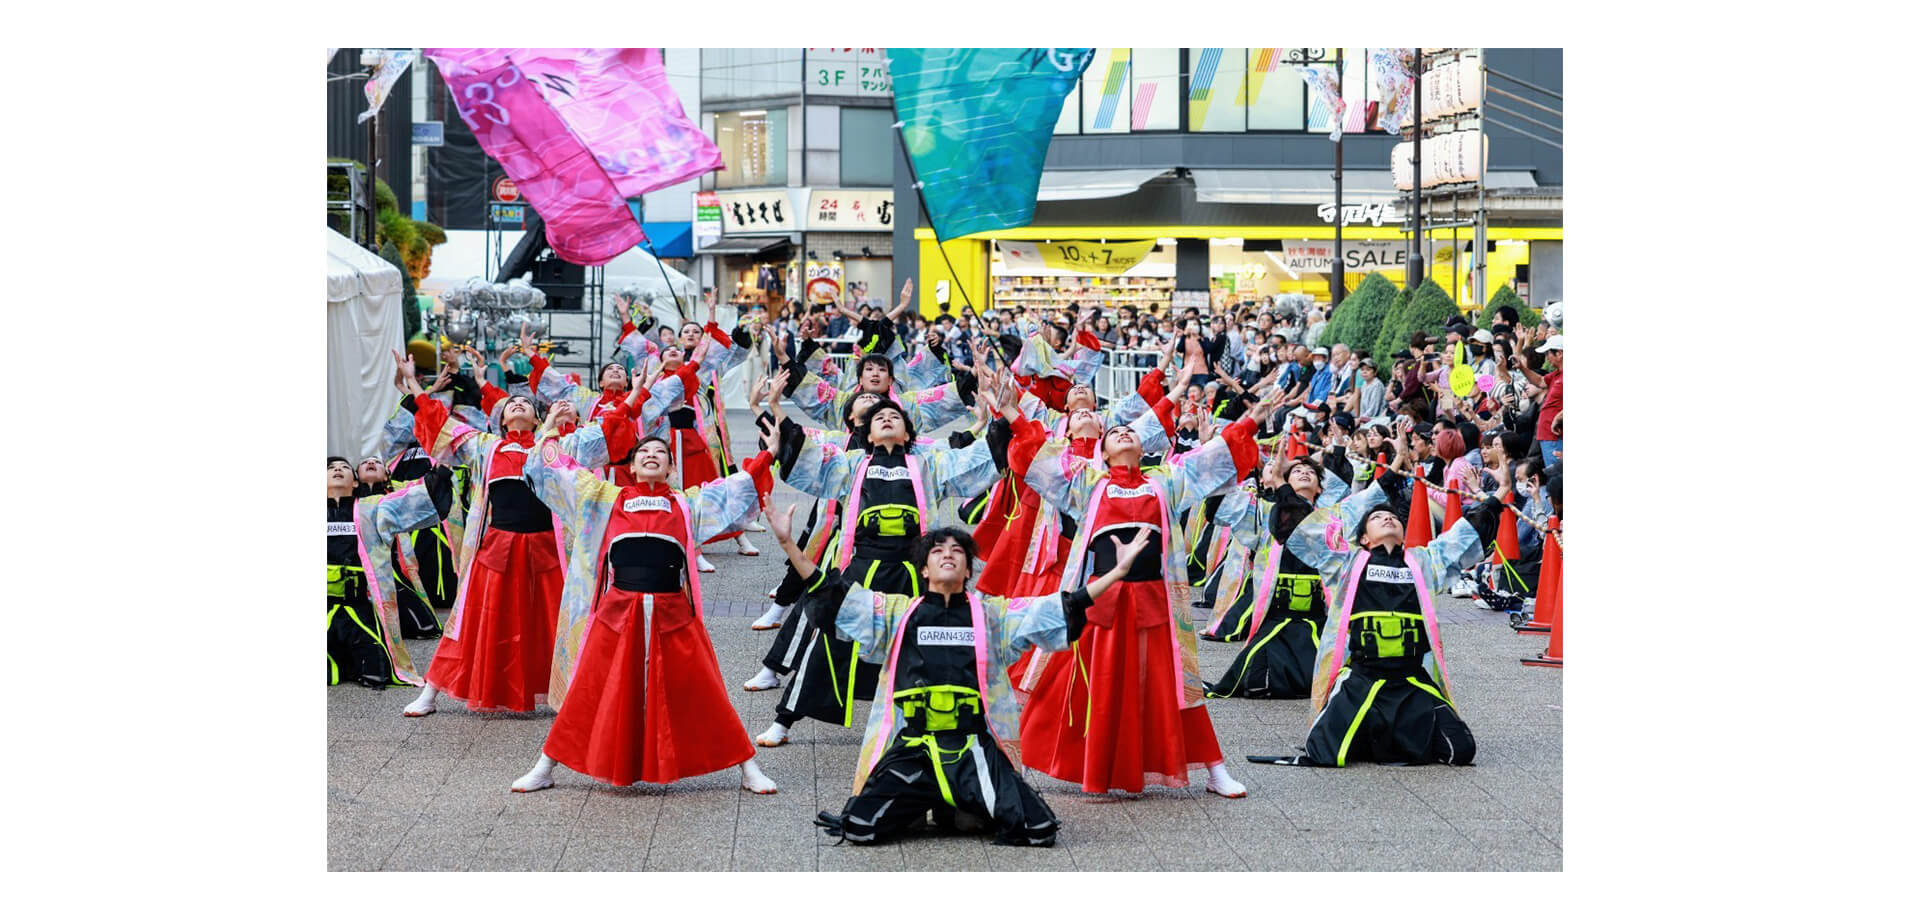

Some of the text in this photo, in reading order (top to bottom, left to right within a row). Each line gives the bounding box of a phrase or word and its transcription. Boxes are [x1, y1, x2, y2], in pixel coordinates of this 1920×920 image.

[820, 200, 838, 210] 24
[1290, 250, 1406, 269] AUTUM SALE
[919, 630, 976, 642] GARAN43/35
